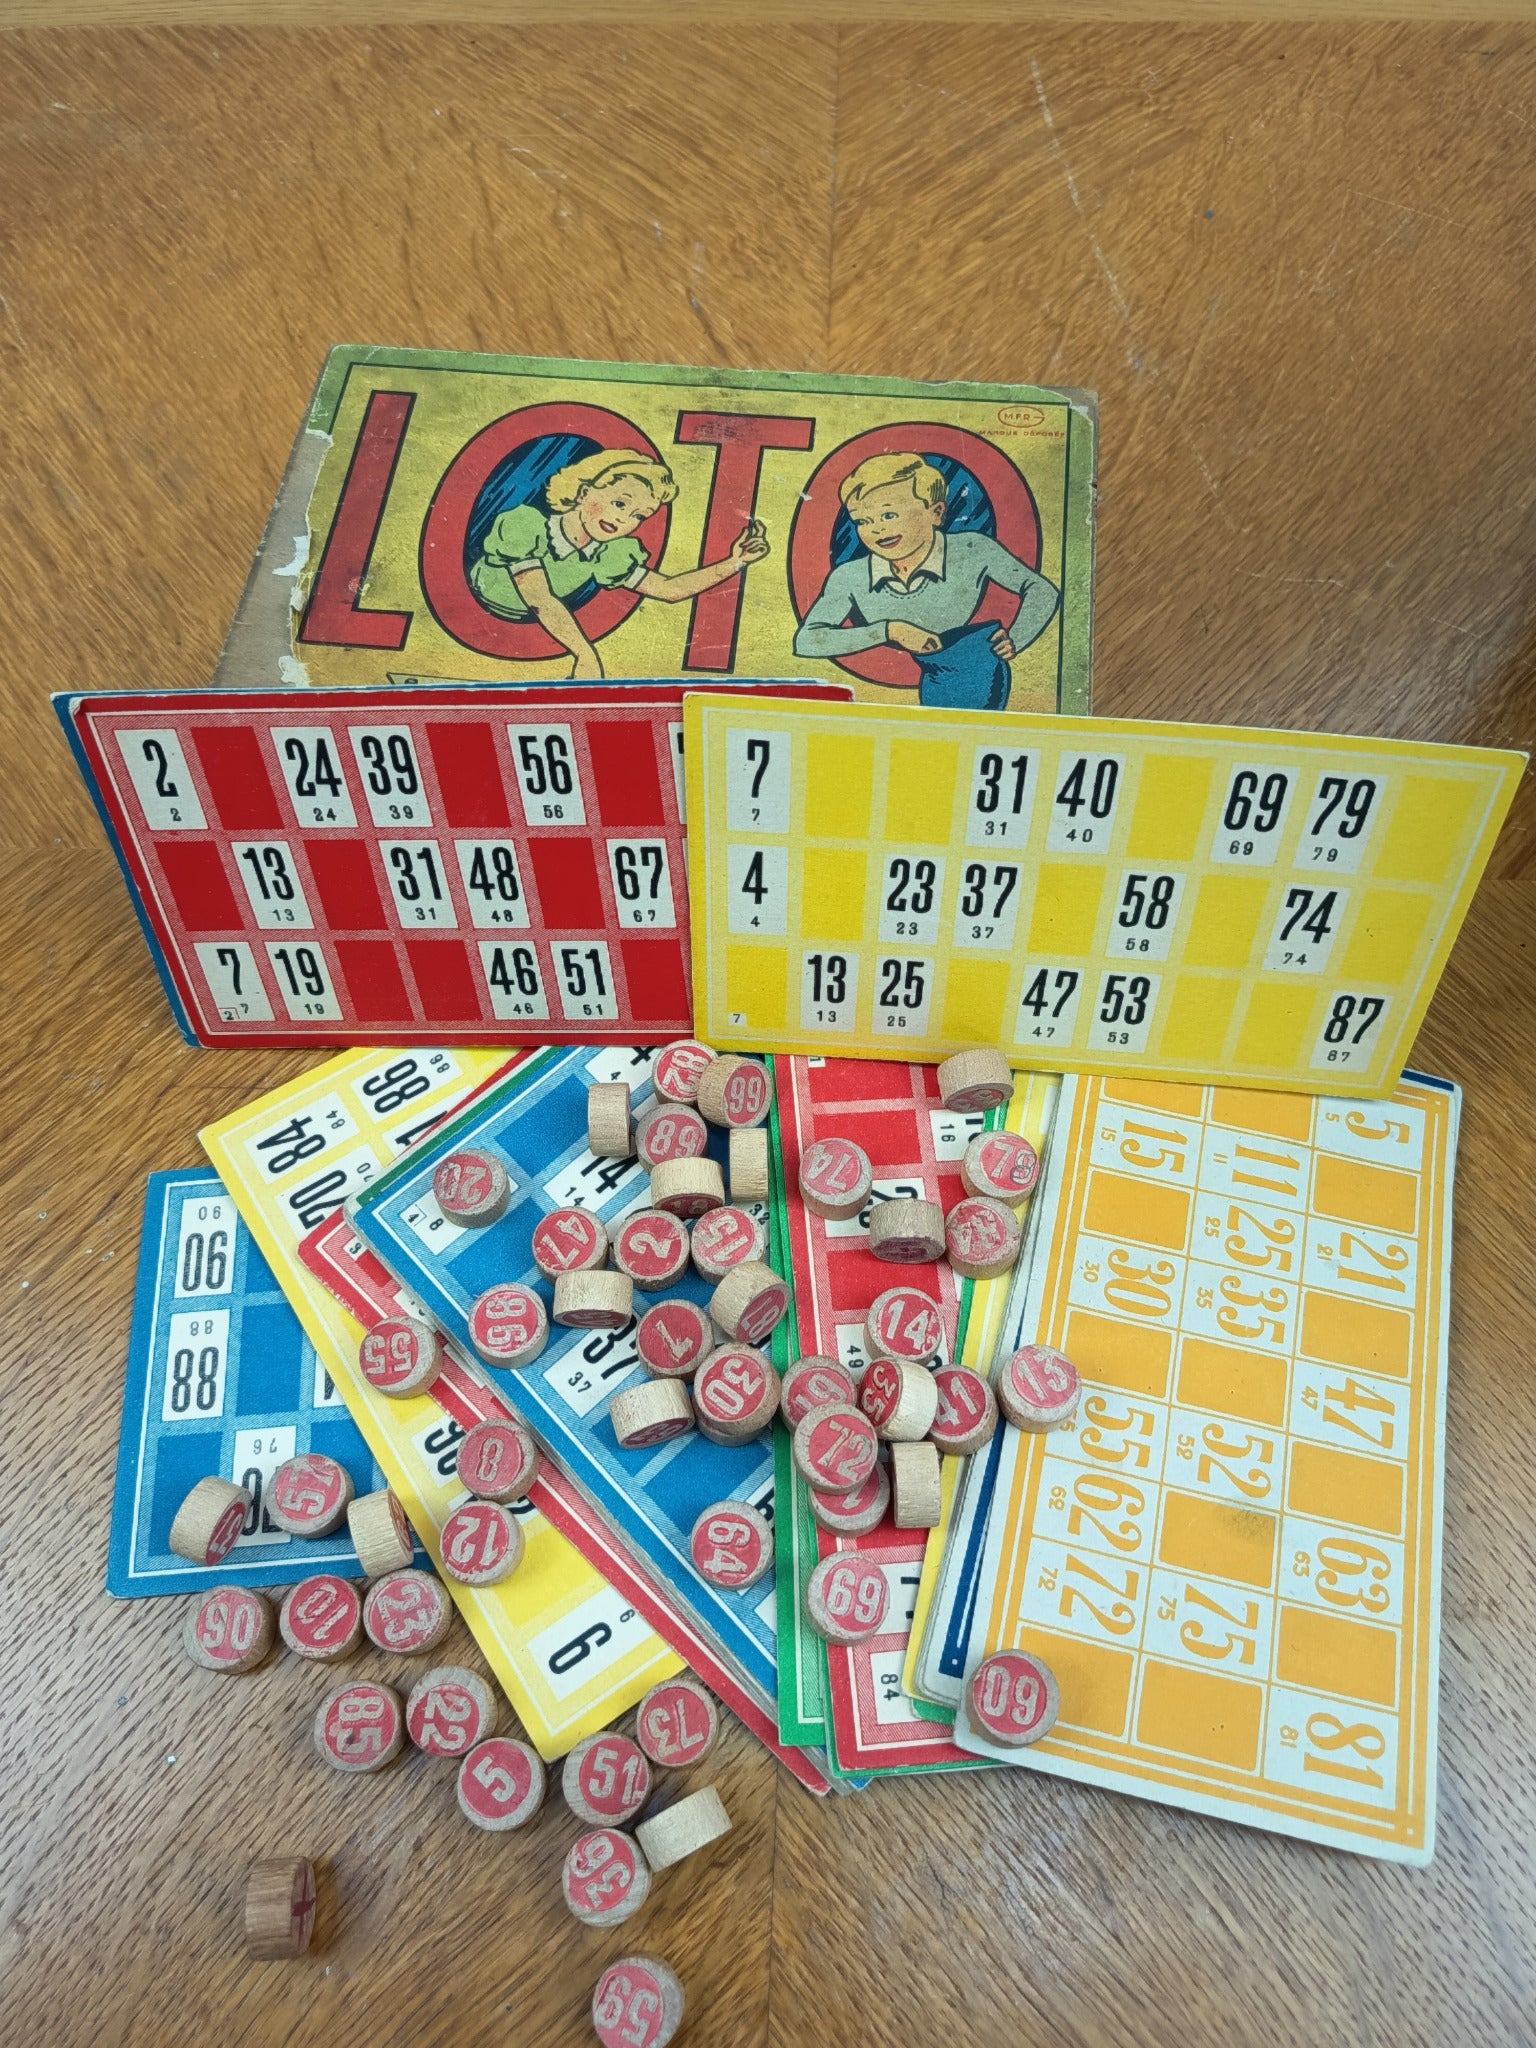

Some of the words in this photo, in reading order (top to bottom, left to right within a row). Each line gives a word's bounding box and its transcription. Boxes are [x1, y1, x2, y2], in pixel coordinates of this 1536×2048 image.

[297, 389, 1043, 690] LOTO
[143, 739, 178, 797] 2
[285, 733, 346, 797] 24
[361, 735, 418, 795] 39
[519, 735, 572, 794] 56
[748, 739, 769, 798] 7
[977, 754, 1028, 813] 31
[1056, 759, 1118, 818] 40
[1224, 771, 1288, 832] 69
[1311, 777, 1376, 838] 79
[170, 808, 181, 821] 2
[313, 808, 336, 821] 24
[389, 805, 413, 819] 39
[543, 805, 563, 818] 56
[752, 808, 760, 821] 7
[985, 821, 1007, 835] 31
[1066, 829, 1092, 842] 40
[1230, 840, 1253, 855] 69
[1312, 847, 1338, 862] 79
[238, 847, 294, 903] 13
[391, 847, 442, 900] 31
[470, 847, 519, 901] 48
[615, 846, 663, 900] 67
[742, 852, 768, 904] 4
[887, 859, 935, 913] 23
[962, 864, 1017, 918] 37
[272, 909, 294, 921] 13
[415, 907, 436, 920] 31
[491, 910, 513, 922] 48
[633, 910, 655, 922] 67
[751, 916, 760, 927] 4
[1119, 875, 1174, 929] 58
[1280, 889, 1337, 943] 74
[897, 922, 917, 935] 23
[972, 926, 993, 938] 37
[1126, 938, 1149, 951] 58
[217, 949, 242, 995] 7
[271, 948, 324, 999] 19
[490, 948, 538, 995] 46
[561, 949, 606, 996] 51
[808, 955, 846, 1003] 13
[1283, 953, 1307, 965] 74
[880, 960, 924, 1008] 25
[1022, 969, 1078, 1017] 47
[1100, 975, 1150, 1025] 53
[220, 1007, 237, 1023] 2
[240, 1004, 248, 1013] 7
[304, 1004, 324, 1014] 19
[513, 1003, 533, 1014] 46
[583, 1004, 602, 1015] 51
[733, 1014, 740, 1023] 7
[817, 1010, 836, 1022] 13
[888, 1016, 906, 1027] 25
[1324, 995, 1384, 1044] 87
[1032, 1027, 1055, 1038] 47
[1108, 1032, 1129, 1044] 53
[430, 1054, 450, 1073] 86
[1327, 1050, 1350, 1062] 87
[363, 1059, 430, 1113] 86
[326, 1111, 345, 1129] 84
[940, 1124, 956, 1143] 16
[1101, 1127, 1116, 1141] 15
[1326, 1113, 1340, 1122] 5
[1346, 1112, 1410, 1144] 5
[257, 1117, 326, 1173] 84
[1120, 1120, 1187, 1173] 15
[1214, 1153, 1228, 1164] 11
[1232, 1144, 1300, 1196] 11
[199, 1206, 221, 1220] 90
[565, 1186, 585, 1206] 14
[429, 1217, 444, 1231] 8
[627, 1231, 672, 1258] 2
[1204, 1216, 1221, 1238] 25
[1225, 1205, 1295, 1272] 25
[183, 1231, 227, 1291] 90
[1084, 1261, 1100, 1283] 30
[1317, 1244, 1333, 1261] 21
[1338, 1232, 1408, 1293] 21
[1104, 1249, 1175, 1316] 30
[1196, 1287, 1213, 1309] 35
[190, 1320, 213, 1336] 88
[1217, 1276, 1288, 1344] 35
[365, 1332, 413, 1375] 55
[847, 1345, 864, 1368] 49
[172, 1347, 219, 1412] 88
[568, 1371, 592, 1393] 37
[705, 1358, 763, 1415] 30
[1018, 1351, 1069, 1401] 13
[1301, 1386, 1318, 1410] 47
[1323, 1378, 1395, 1449] 47
[1080, 1396, 1154, 1468] 55
[1176, 1434, 1195, 1460] 52
[477, 1438, 504, 1482] 8
[1198, 1424, 1274, 1498] 52
[1049, 1486, 1066, 1511] 62
[1068, 1474, 1145, 1552] 62
[452, 1516, 499, 1566] 12
[1038, 1567, 1058, 1592] 72
[1293, 1551, 1311, 1577] 63
[1315, 1538, 1391, 1613] 63
[1059, 1554, 1139, 1635] 72
[1158, 1596, 1177, 1621] 75
[202, 1603, 255, 1649] 90
[1180, 1584, 1259, 1665] 75
[881, 1673, 900, 1701] 84
[336, 1696, 385, 1754] 85
[420, 1692, 471, 1750] 22
[647, 1705, 704, 1756] 73
[1280, 1725, 1299, 1748] 81
[1304, 1713, 1385, 1789] 81
[472, 1755, 517, 1802] 5
